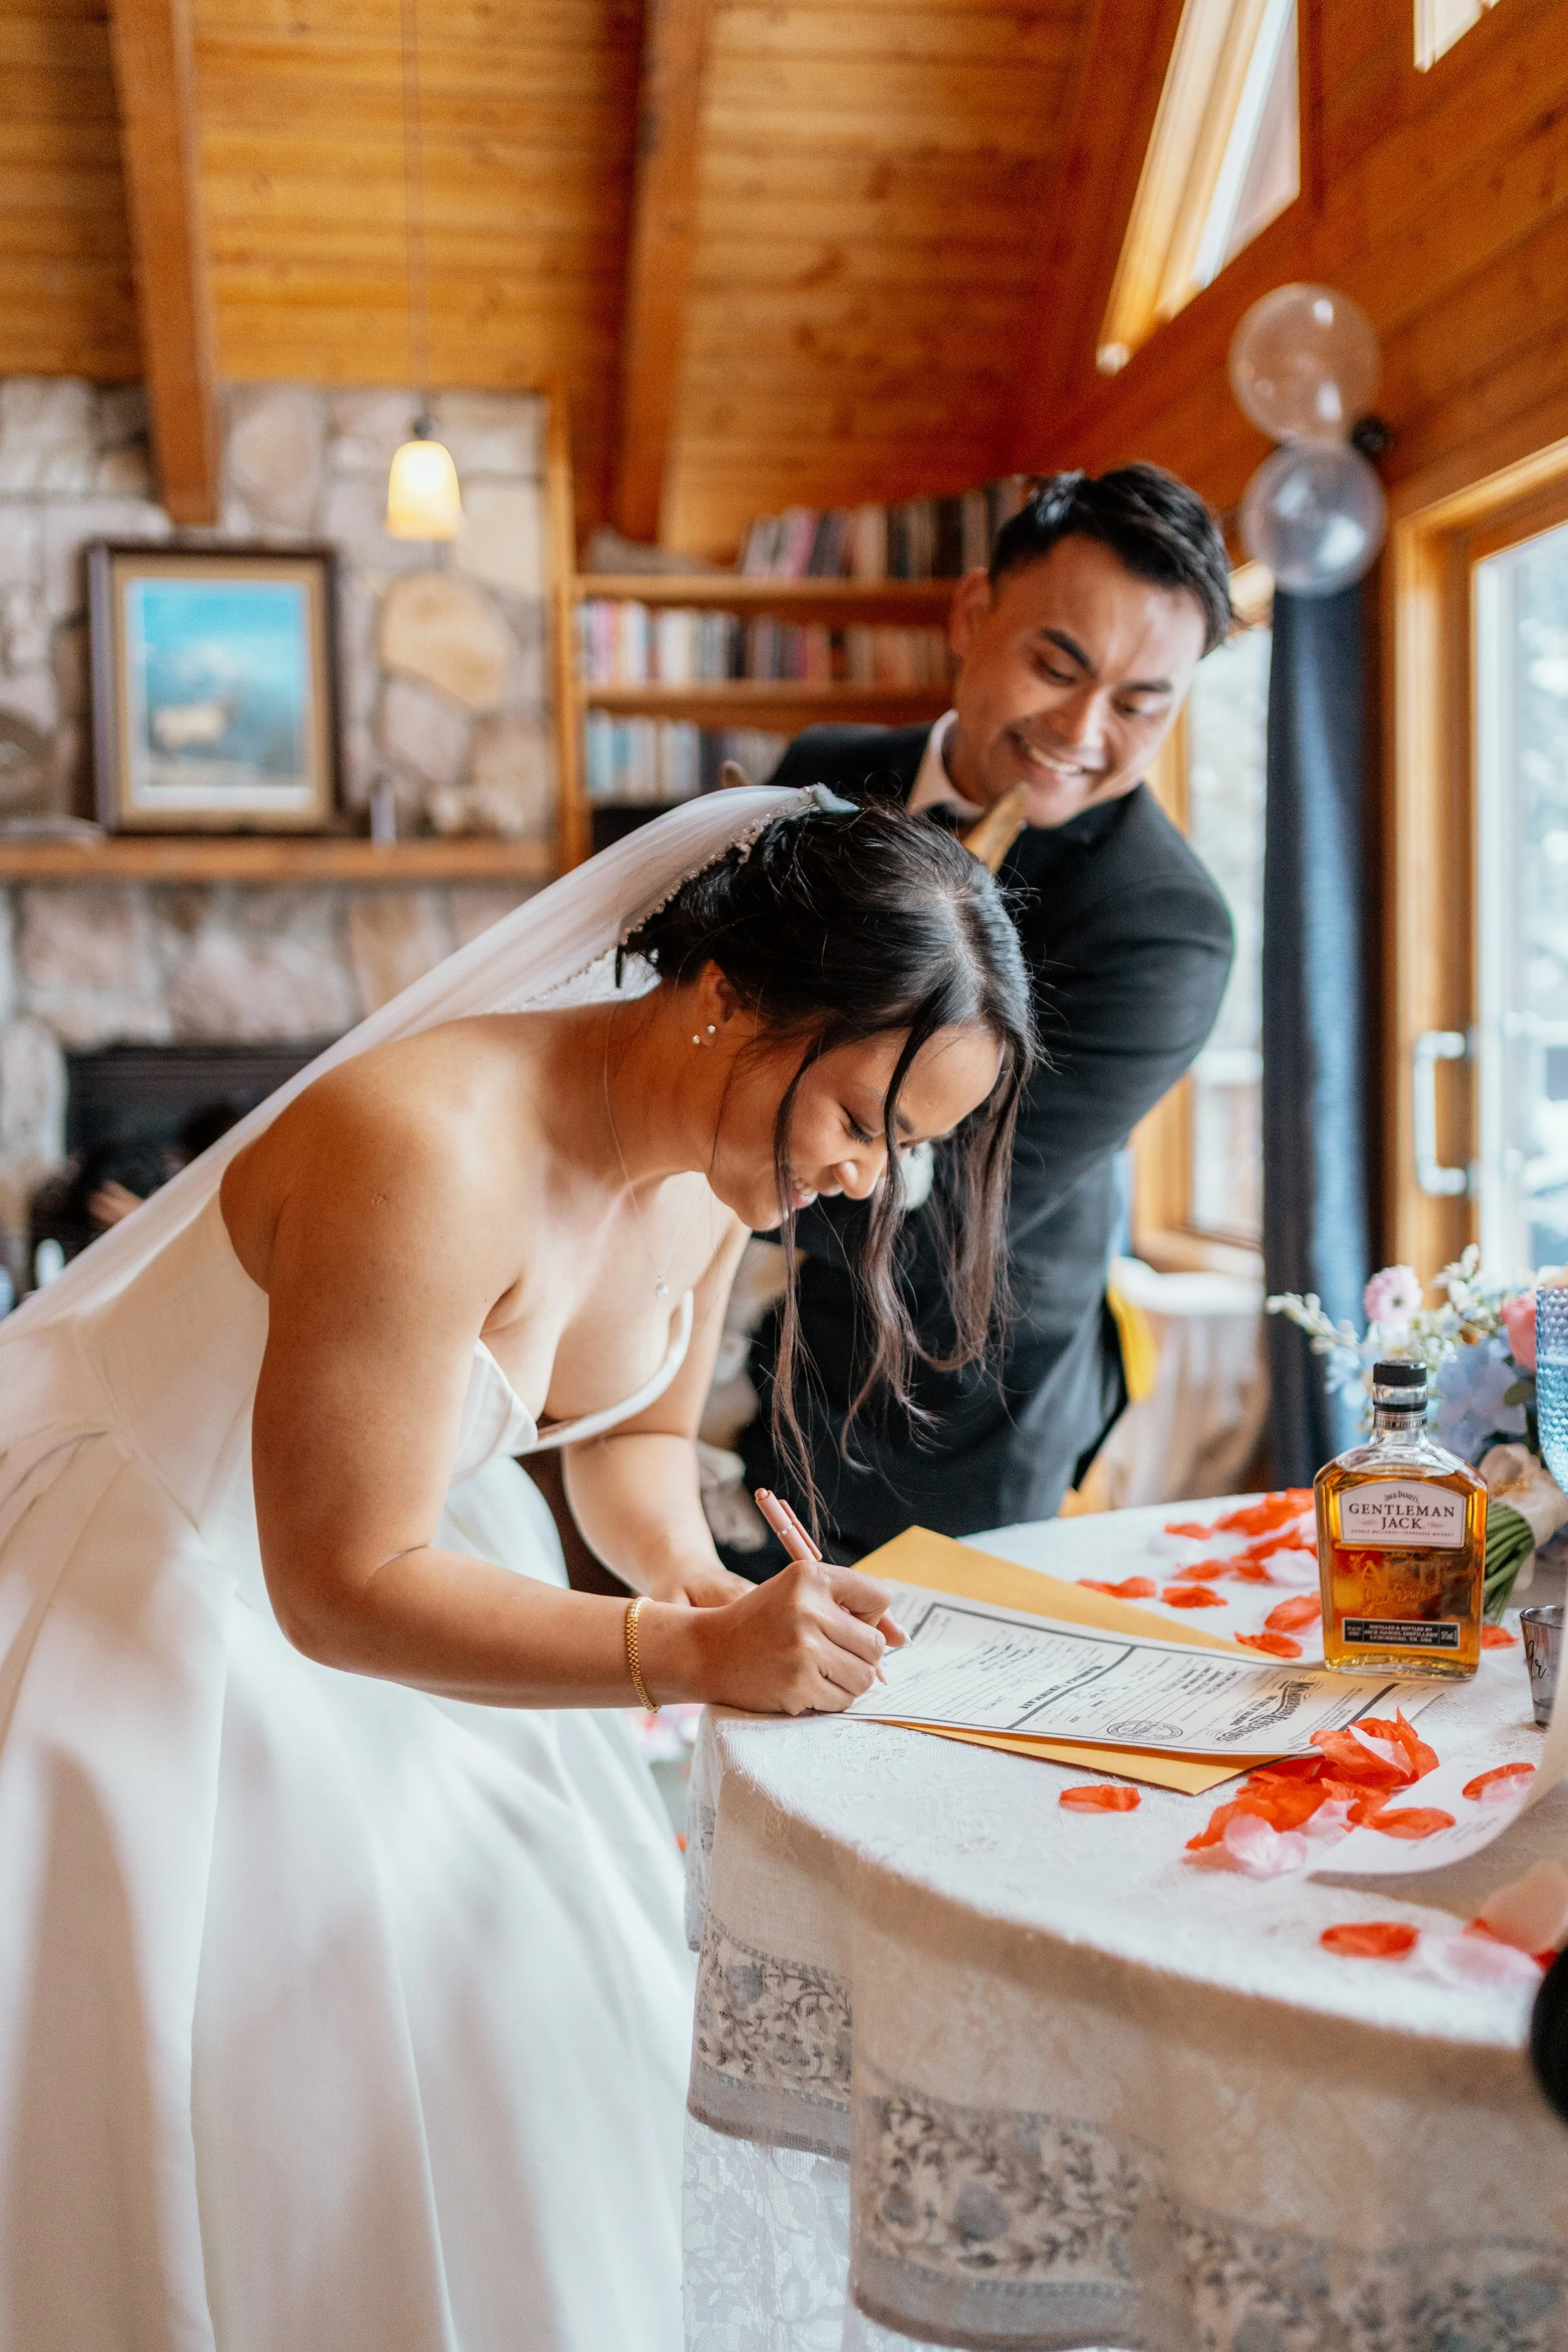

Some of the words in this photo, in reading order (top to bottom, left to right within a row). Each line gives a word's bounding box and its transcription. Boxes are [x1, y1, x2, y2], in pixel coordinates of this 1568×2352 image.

[1385, 1492, 1396, 1502] JACK
[1398, 1490, 1419, 1502] DANIEL'S
[1349, 1503, 1454, 1517] GENTLEMAN
[1382, 1517, 1422, 1529] JACK
